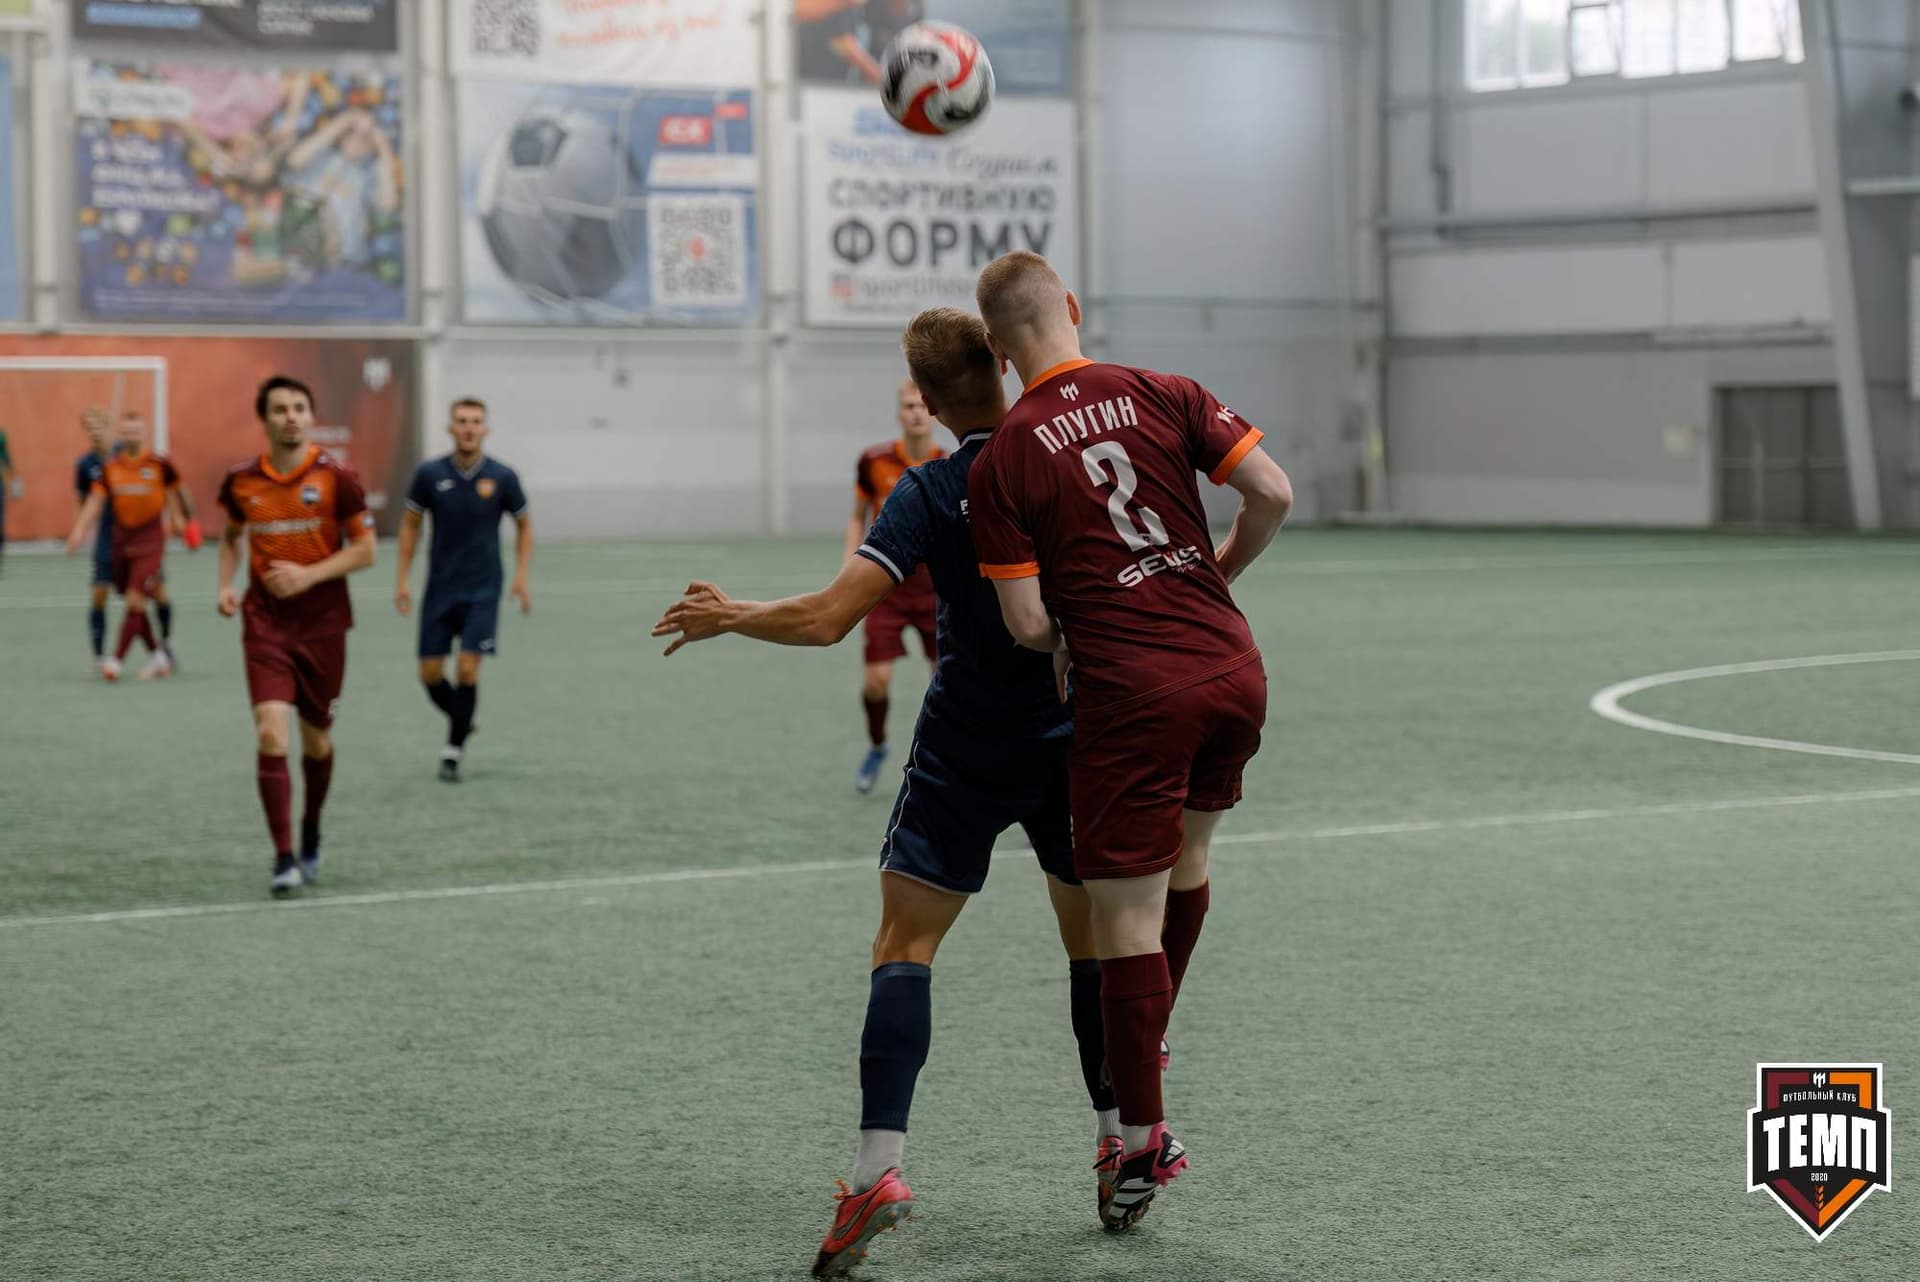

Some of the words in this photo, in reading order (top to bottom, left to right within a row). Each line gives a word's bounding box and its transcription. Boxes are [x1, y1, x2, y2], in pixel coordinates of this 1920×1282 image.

[829, 178, 1055, 213] СПОРТИВНУЮ
[833, 217, 1051, 268] ФОРМУ
[1033, 395, 1138, 455] ПЛУГИН
[1081, 440, 1169, 552] 2
